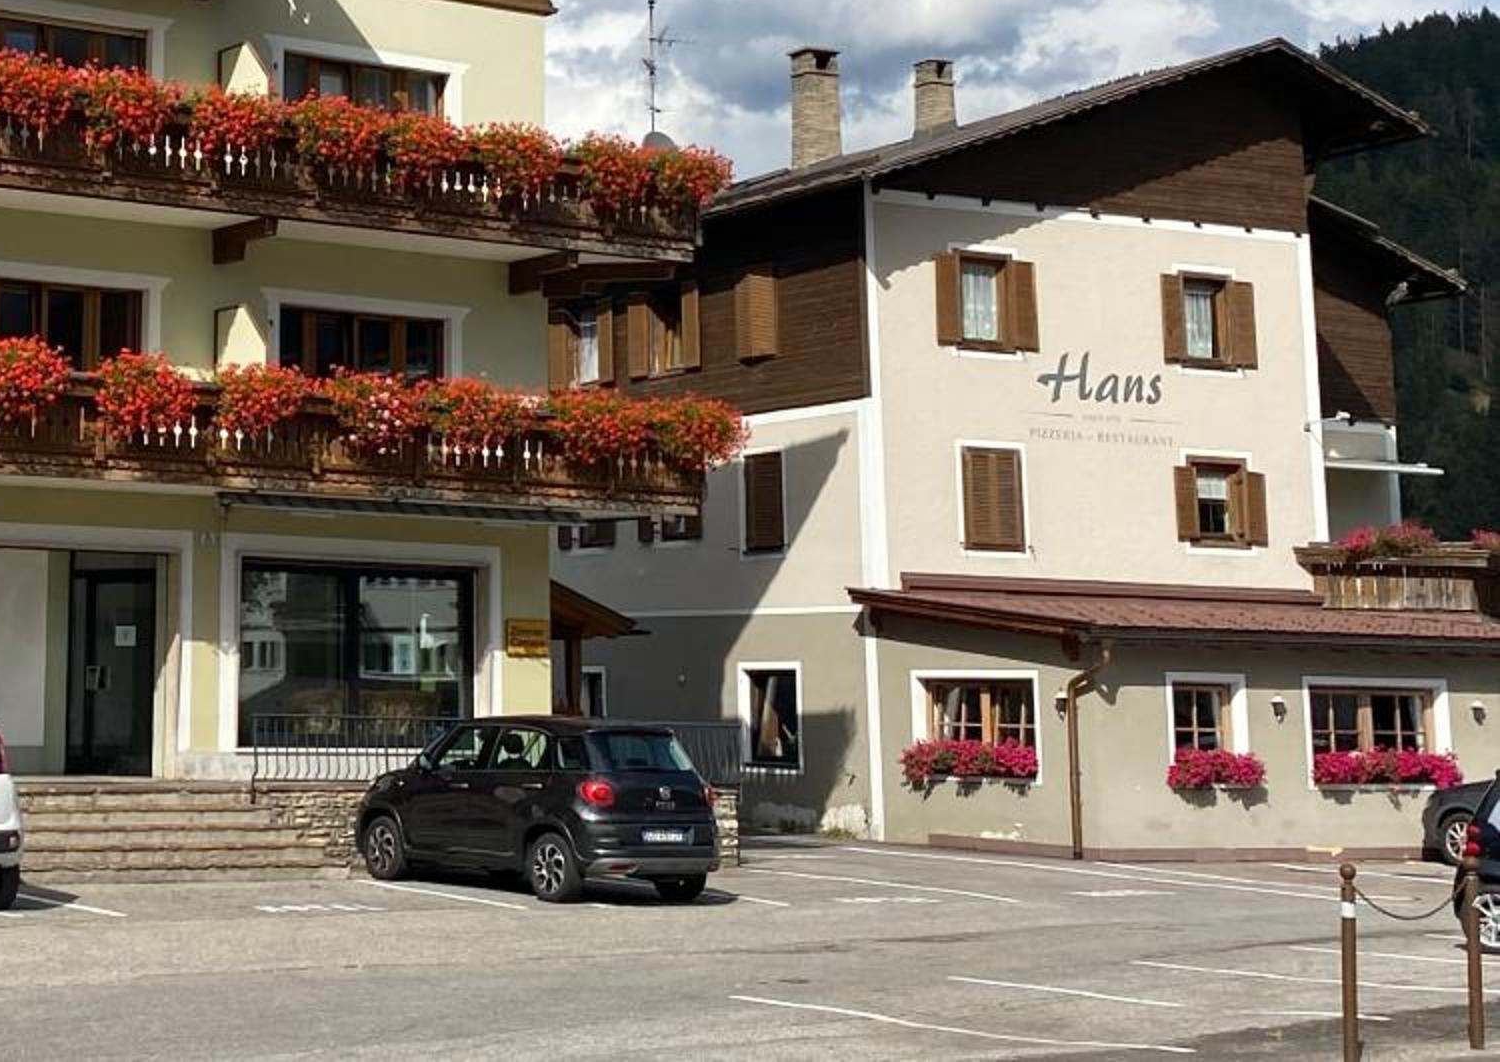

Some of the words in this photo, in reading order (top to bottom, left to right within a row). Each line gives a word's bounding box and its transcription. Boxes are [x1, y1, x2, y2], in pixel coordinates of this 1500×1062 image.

[1037, 352, 1162, 404] Hans
[1029, 427, 1083, 441] PIZZERIA
[1097, 431, 1173, 447] RESTAURANT
